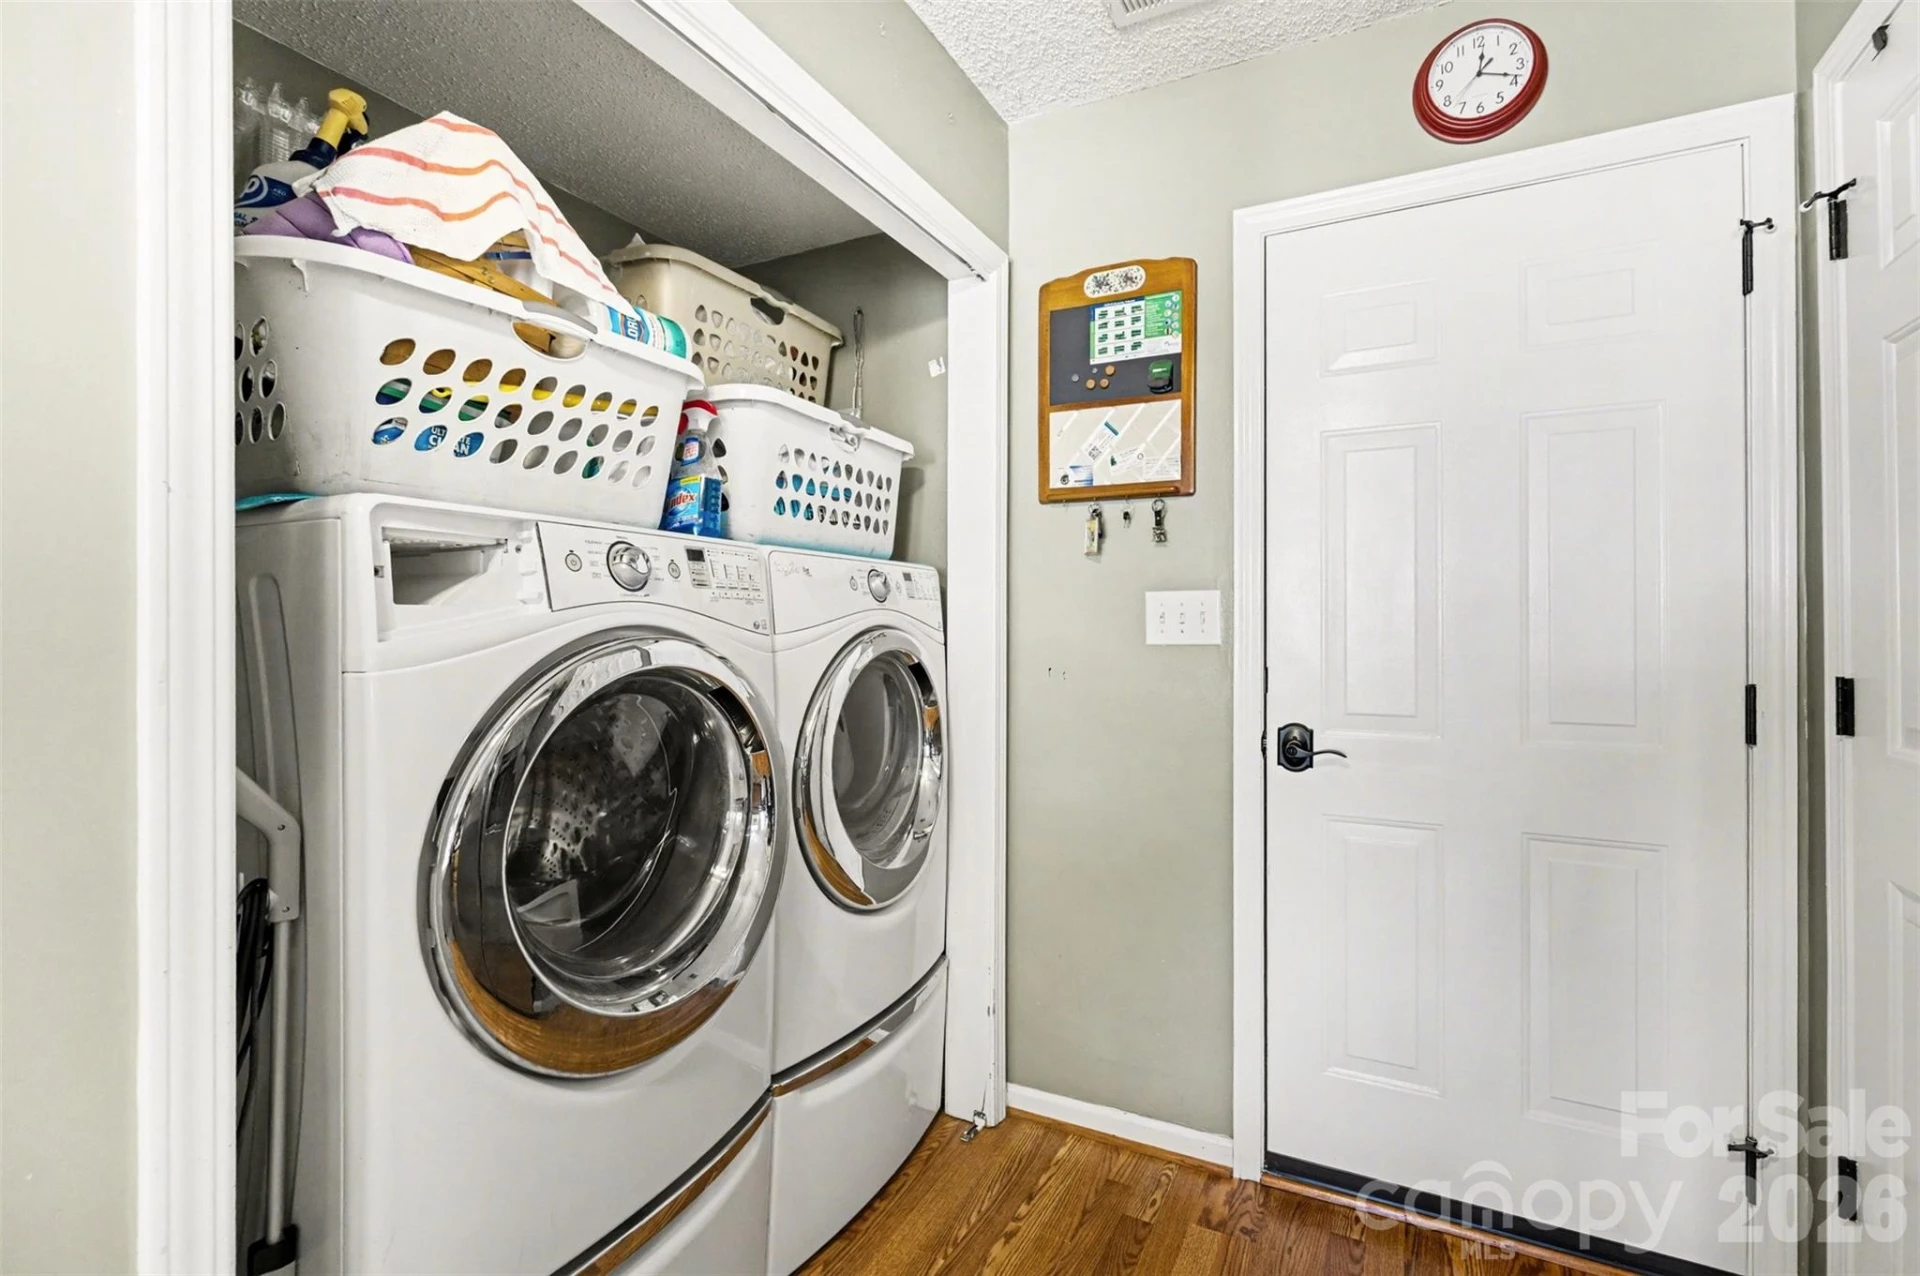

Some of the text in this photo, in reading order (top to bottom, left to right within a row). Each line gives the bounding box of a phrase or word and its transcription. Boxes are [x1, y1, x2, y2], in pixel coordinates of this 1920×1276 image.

[1473, 35, 1485, 49] 12
[1457, 45, 1465, 58] 11
[1509, 42, 1518, 56] 2
[1441, 61, 1454, 75] 10
[1516, 57, 1525, 70] 3
[1435, 79, 1444, 92] 9
[1509, 74, 1518, 87] 4
[1443, 95, 1452, 107] 8
[1495, 91, 1504, 105] 5
[1458, 101, 1466, 114] 7
[1476, 102, 1485, 114] 6
